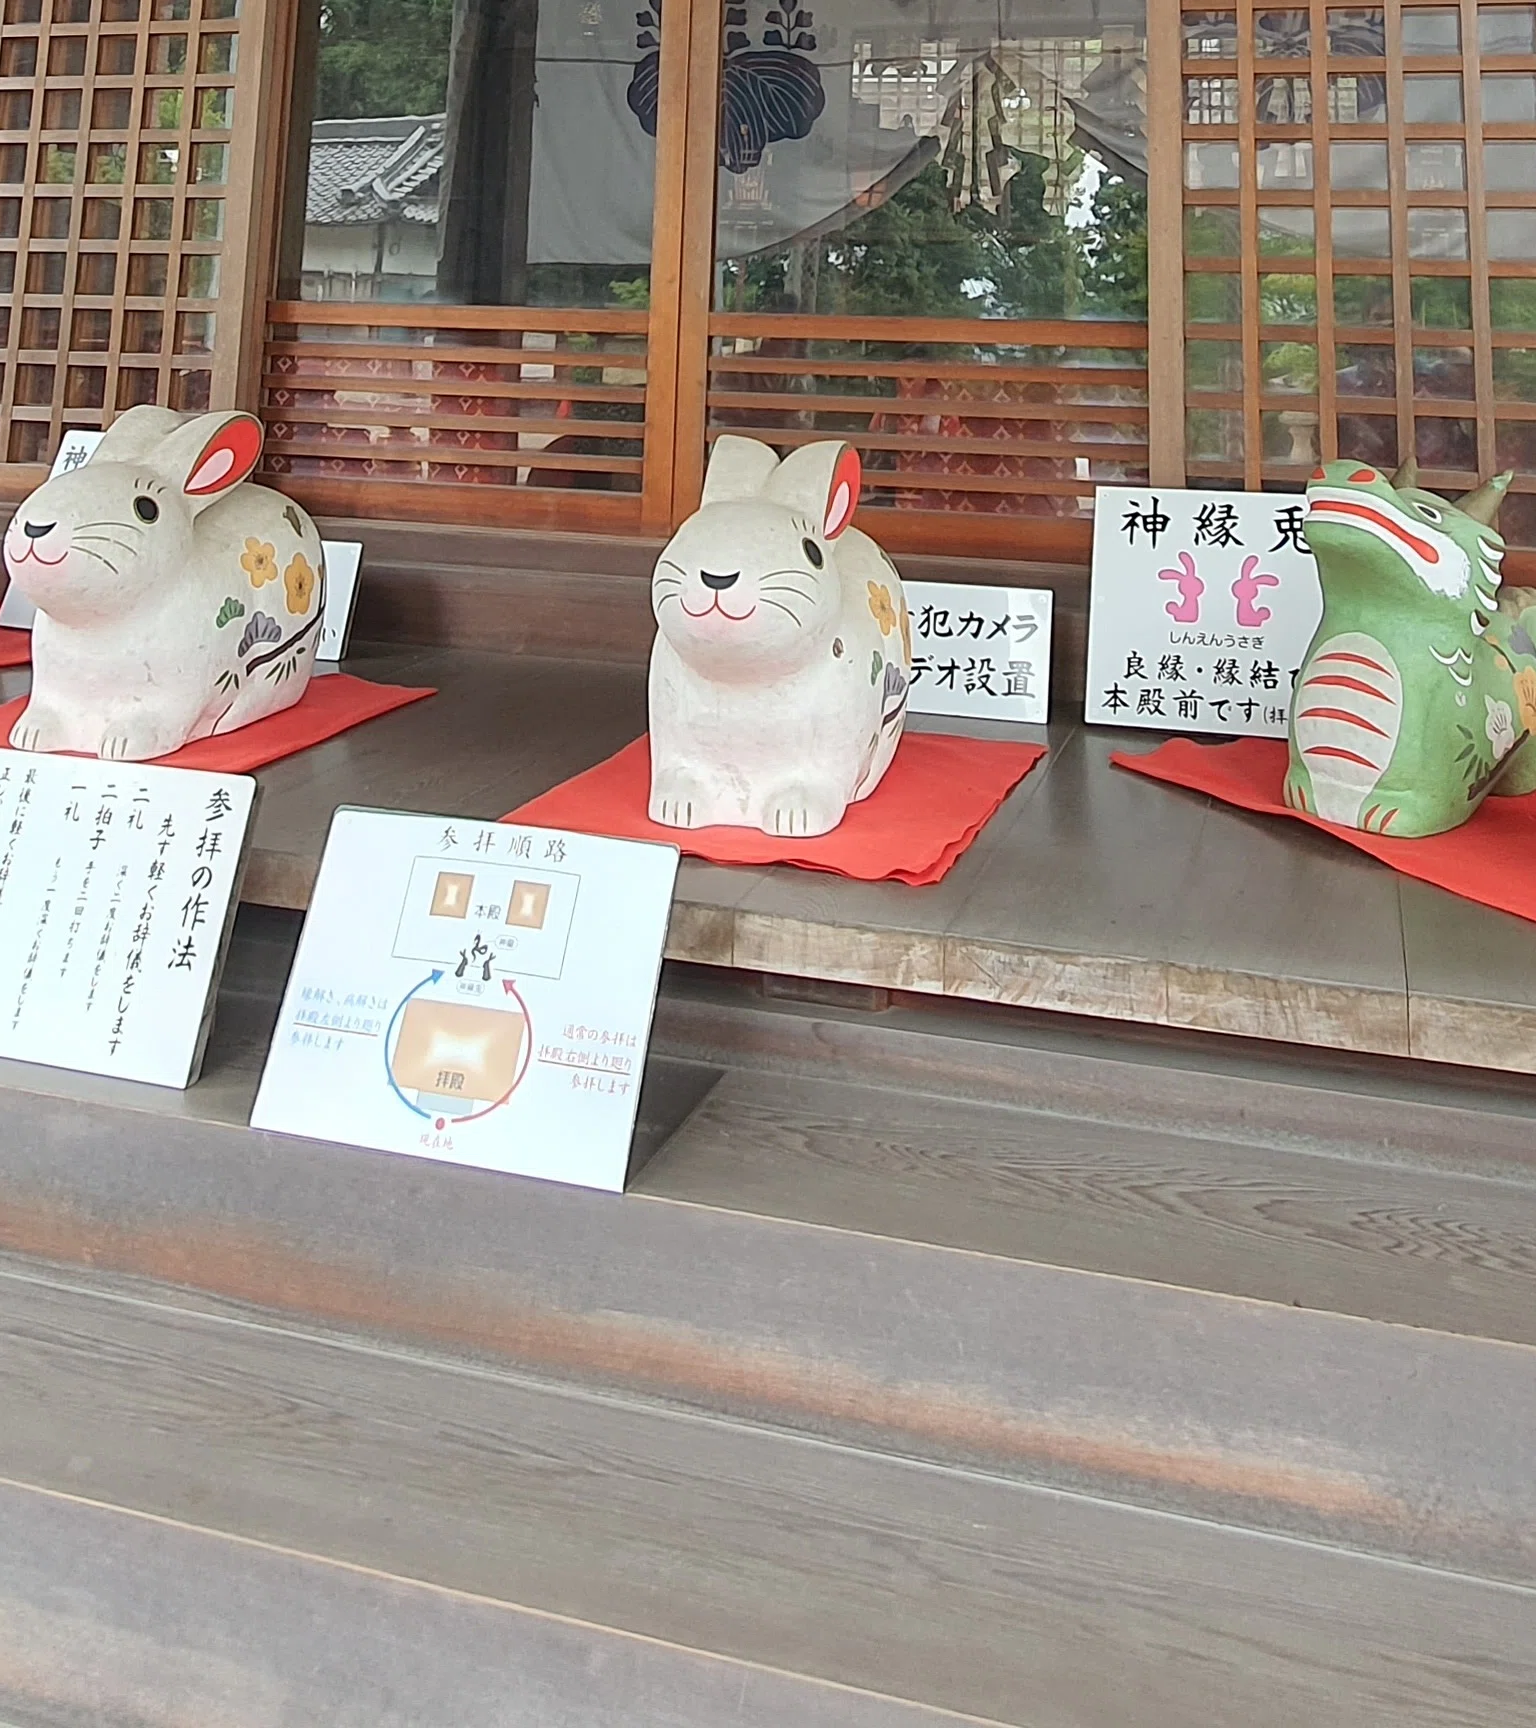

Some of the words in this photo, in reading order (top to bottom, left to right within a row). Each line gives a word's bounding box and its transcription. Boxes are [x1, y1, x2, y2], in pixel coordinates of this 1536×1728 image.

[1120, 495, 1314, 555] 神縁兎
[907, 604, 1039, 644] 犯カメラ
[1169, 631, 1265, 650] しんえんうさぎ
[63, 785, 88, 823] 一礼
[88, 784, 119, 852] 二拍子
[127, 787, 151, 831] 二礼
[438, 825, 568, 863] 参拝順路
[166, 786, 234, 973] 参拝の作法
[473, 902, 502, 922] 本殿
[434, 1069, 465, 1091] 拝殿
